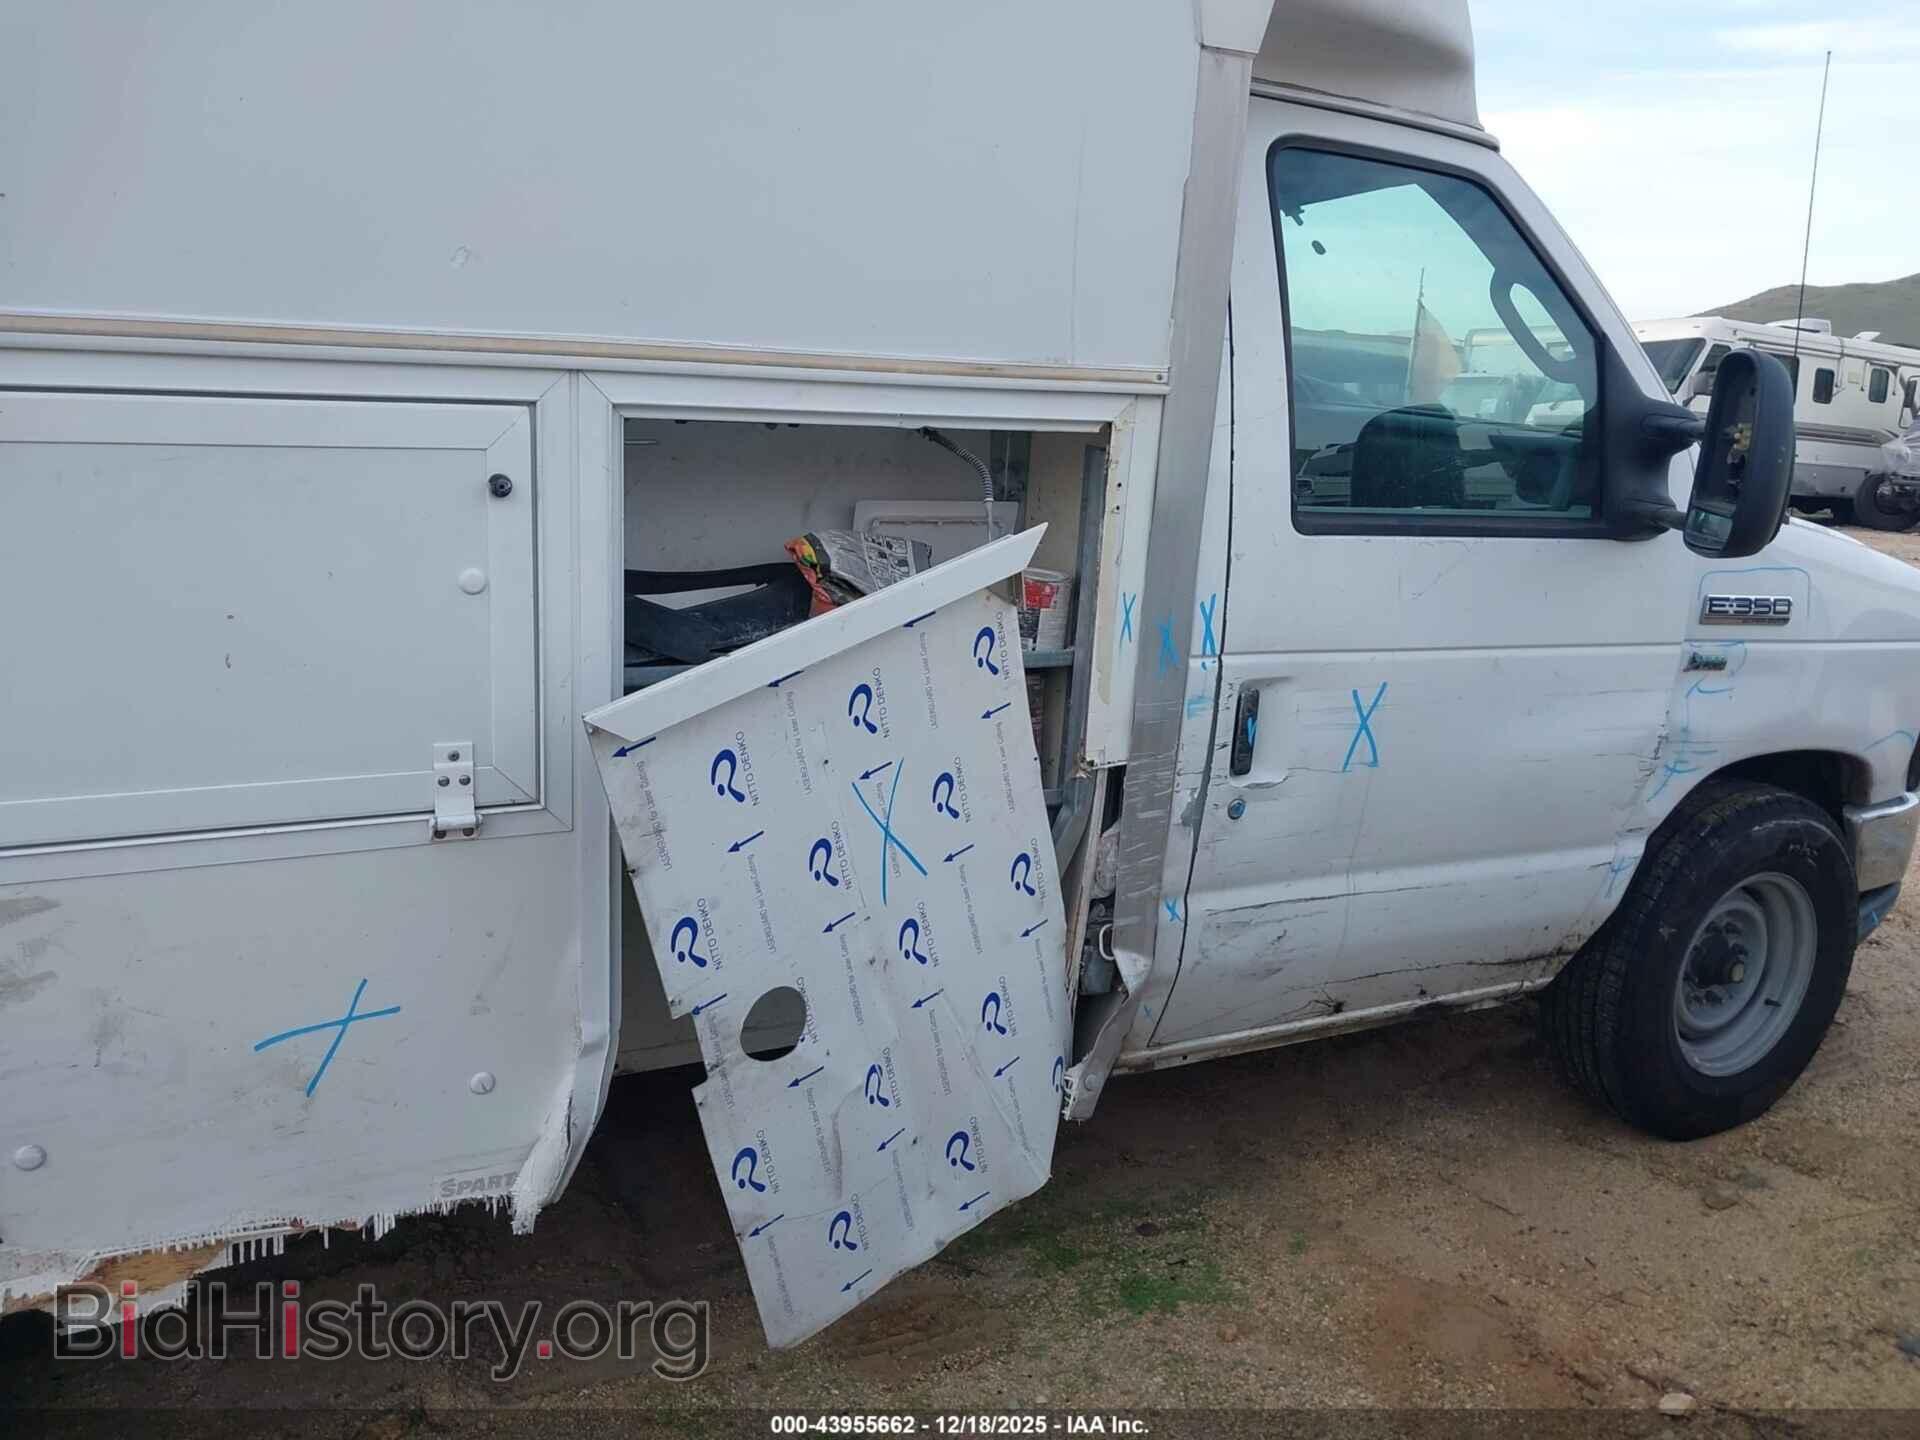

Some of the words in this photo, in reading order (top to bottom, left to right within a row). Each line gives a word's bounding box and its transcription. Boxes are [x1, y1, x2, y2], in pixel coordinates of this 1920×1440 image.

[994, 612, 1007, 647] DENKO
[998, 649, 1012, 679] NITTO
[870, 667, 885, 705] DENKO
[877, 707, 891, 738] NITTO
[734, 729, 753, 771] DENKO
[744, 772, 761, 806] NITTO
[952, 756, 966, 791] DENKO
[959, 792, 973, 822] NITTO
[830, 819, 846, 856] DENKO
[838, 859, 853, 889] NITTO
[696, 896, 714, 935] DENKO
[916, 901, 932, 936] DENKO
[706, 936, 724, 970] NITTO
[926, 938, 941, 967] NITTO
[880, 1046, 895, 1078] DENKO
[888, 1079, 902, 1107] NITTO
[755, 1129, 772, 1163] DENKO
[765, 1163, 781, 1194] NITTO
